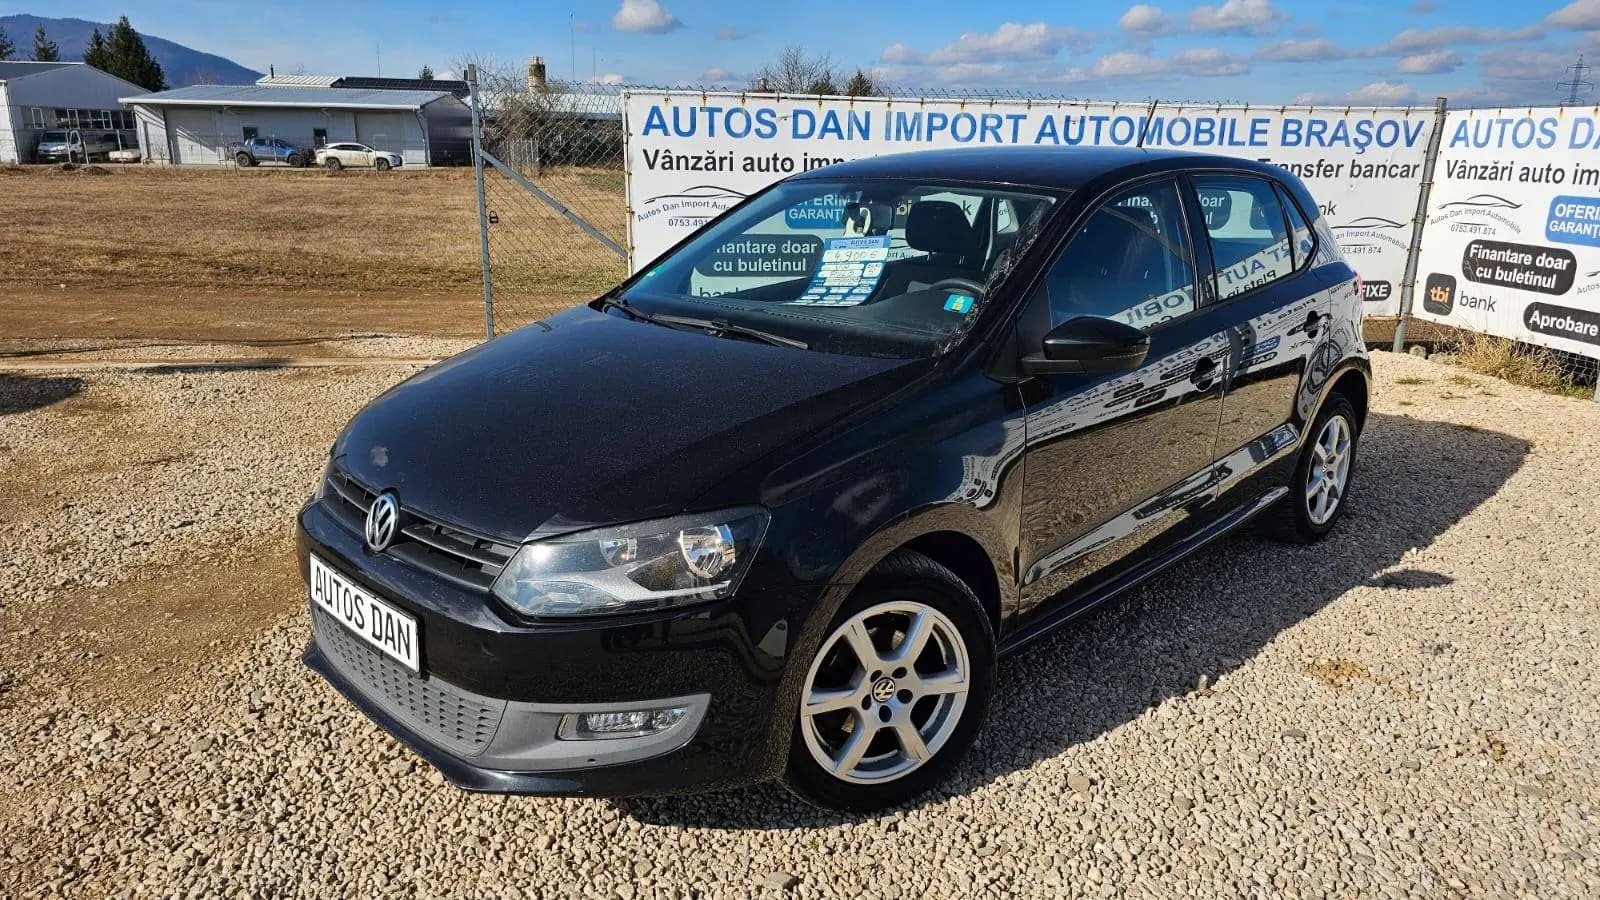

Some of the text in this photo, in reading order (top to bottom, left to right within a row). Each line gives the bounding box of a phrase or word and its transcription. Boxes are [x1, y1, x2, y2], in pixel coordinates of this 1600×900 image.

[642, 105, 777, 139] AUTOS
[792, 109, 871, 141] DAN
[885, 111, 1027, 144] IMPORT
[1034, 114, 1270, 147] AUTOMOBILE
[1450, 117, 1559, 149] AUTOS
[642, 149, 734, 172] Vânzări
[742, 152, 795, 173] auto
[1350, 159, 1420, 179] bancar
[1446, 159, 1600, 194] Vânzări auto im
[637, 208, 662, 223] Autos
[662, 202, 680, 213] Dan
[681, 199, 711, 210] Import
[1450, 224, 1496, 236] 0753.491.874
[782, 240, 818, 255] doar
[1469, 244, 1571, 271] Finantare doar
[713, 258, 807, 272] cu buletinul
[1475, 265, 1557, 289] cu buletinul
[1430, 286, 1497, 313] tbi bank
[1529, 309, 1599, 336] Aprobare
[315, 565, 411, 660] AUTOS DAN
